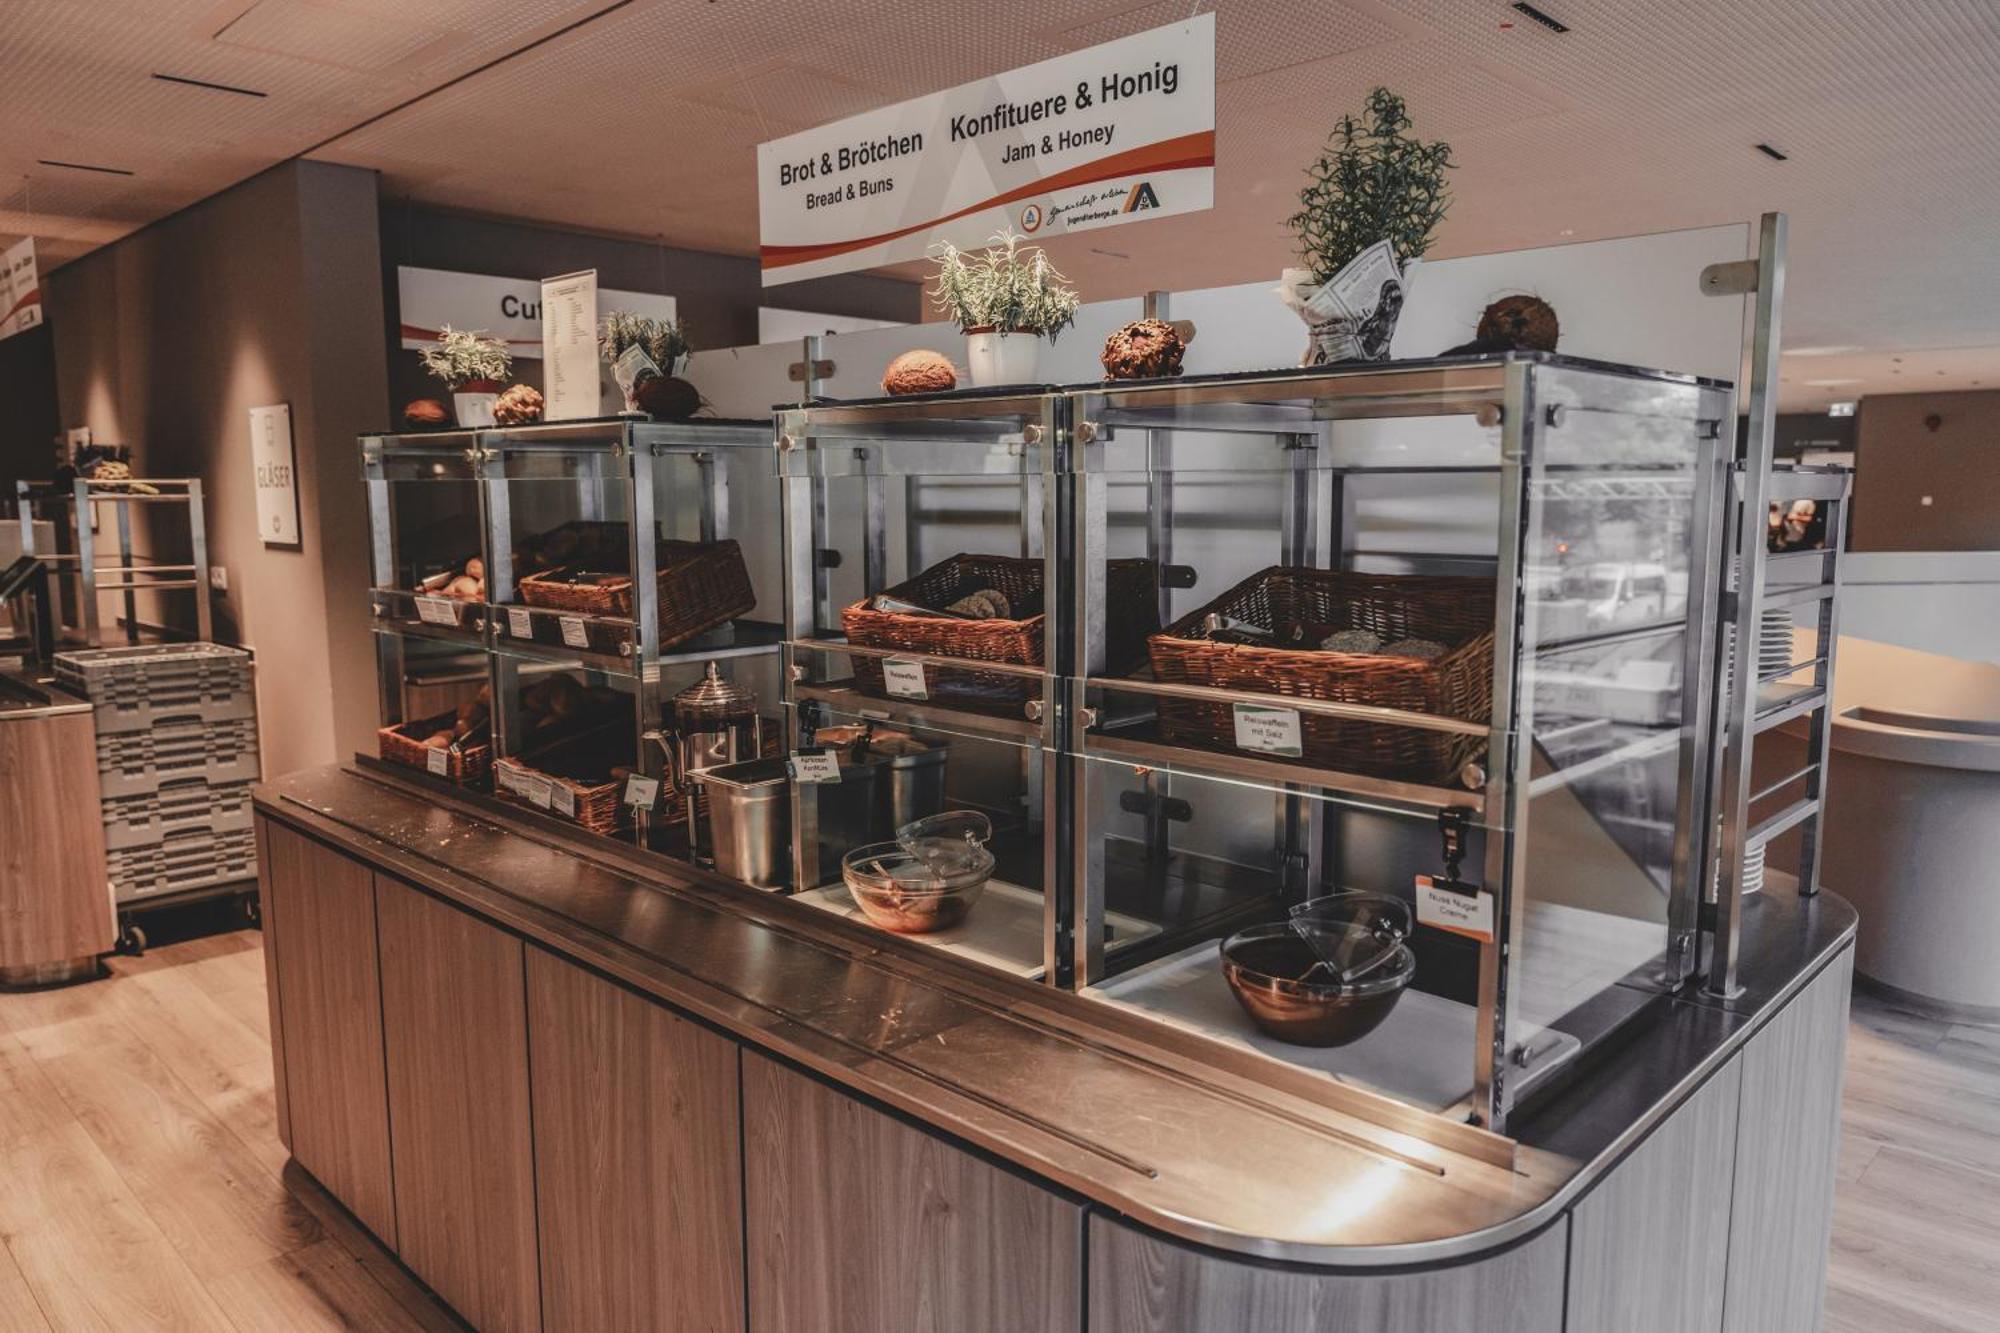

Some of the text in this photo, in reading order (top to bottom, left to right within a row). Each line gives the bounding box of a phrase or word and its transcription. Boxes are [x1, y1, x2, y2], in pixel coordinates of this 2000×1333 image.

[951, 62, 1178, 142] Konfituere & Honig
[780, 133, 922, 186] Brot & Brötchen
[1002, 124, 1114, 164] Jam & Honey
[806, 178, 893, 209] Bread & Buns
[258, 460, 290, 488] GLÄSER
